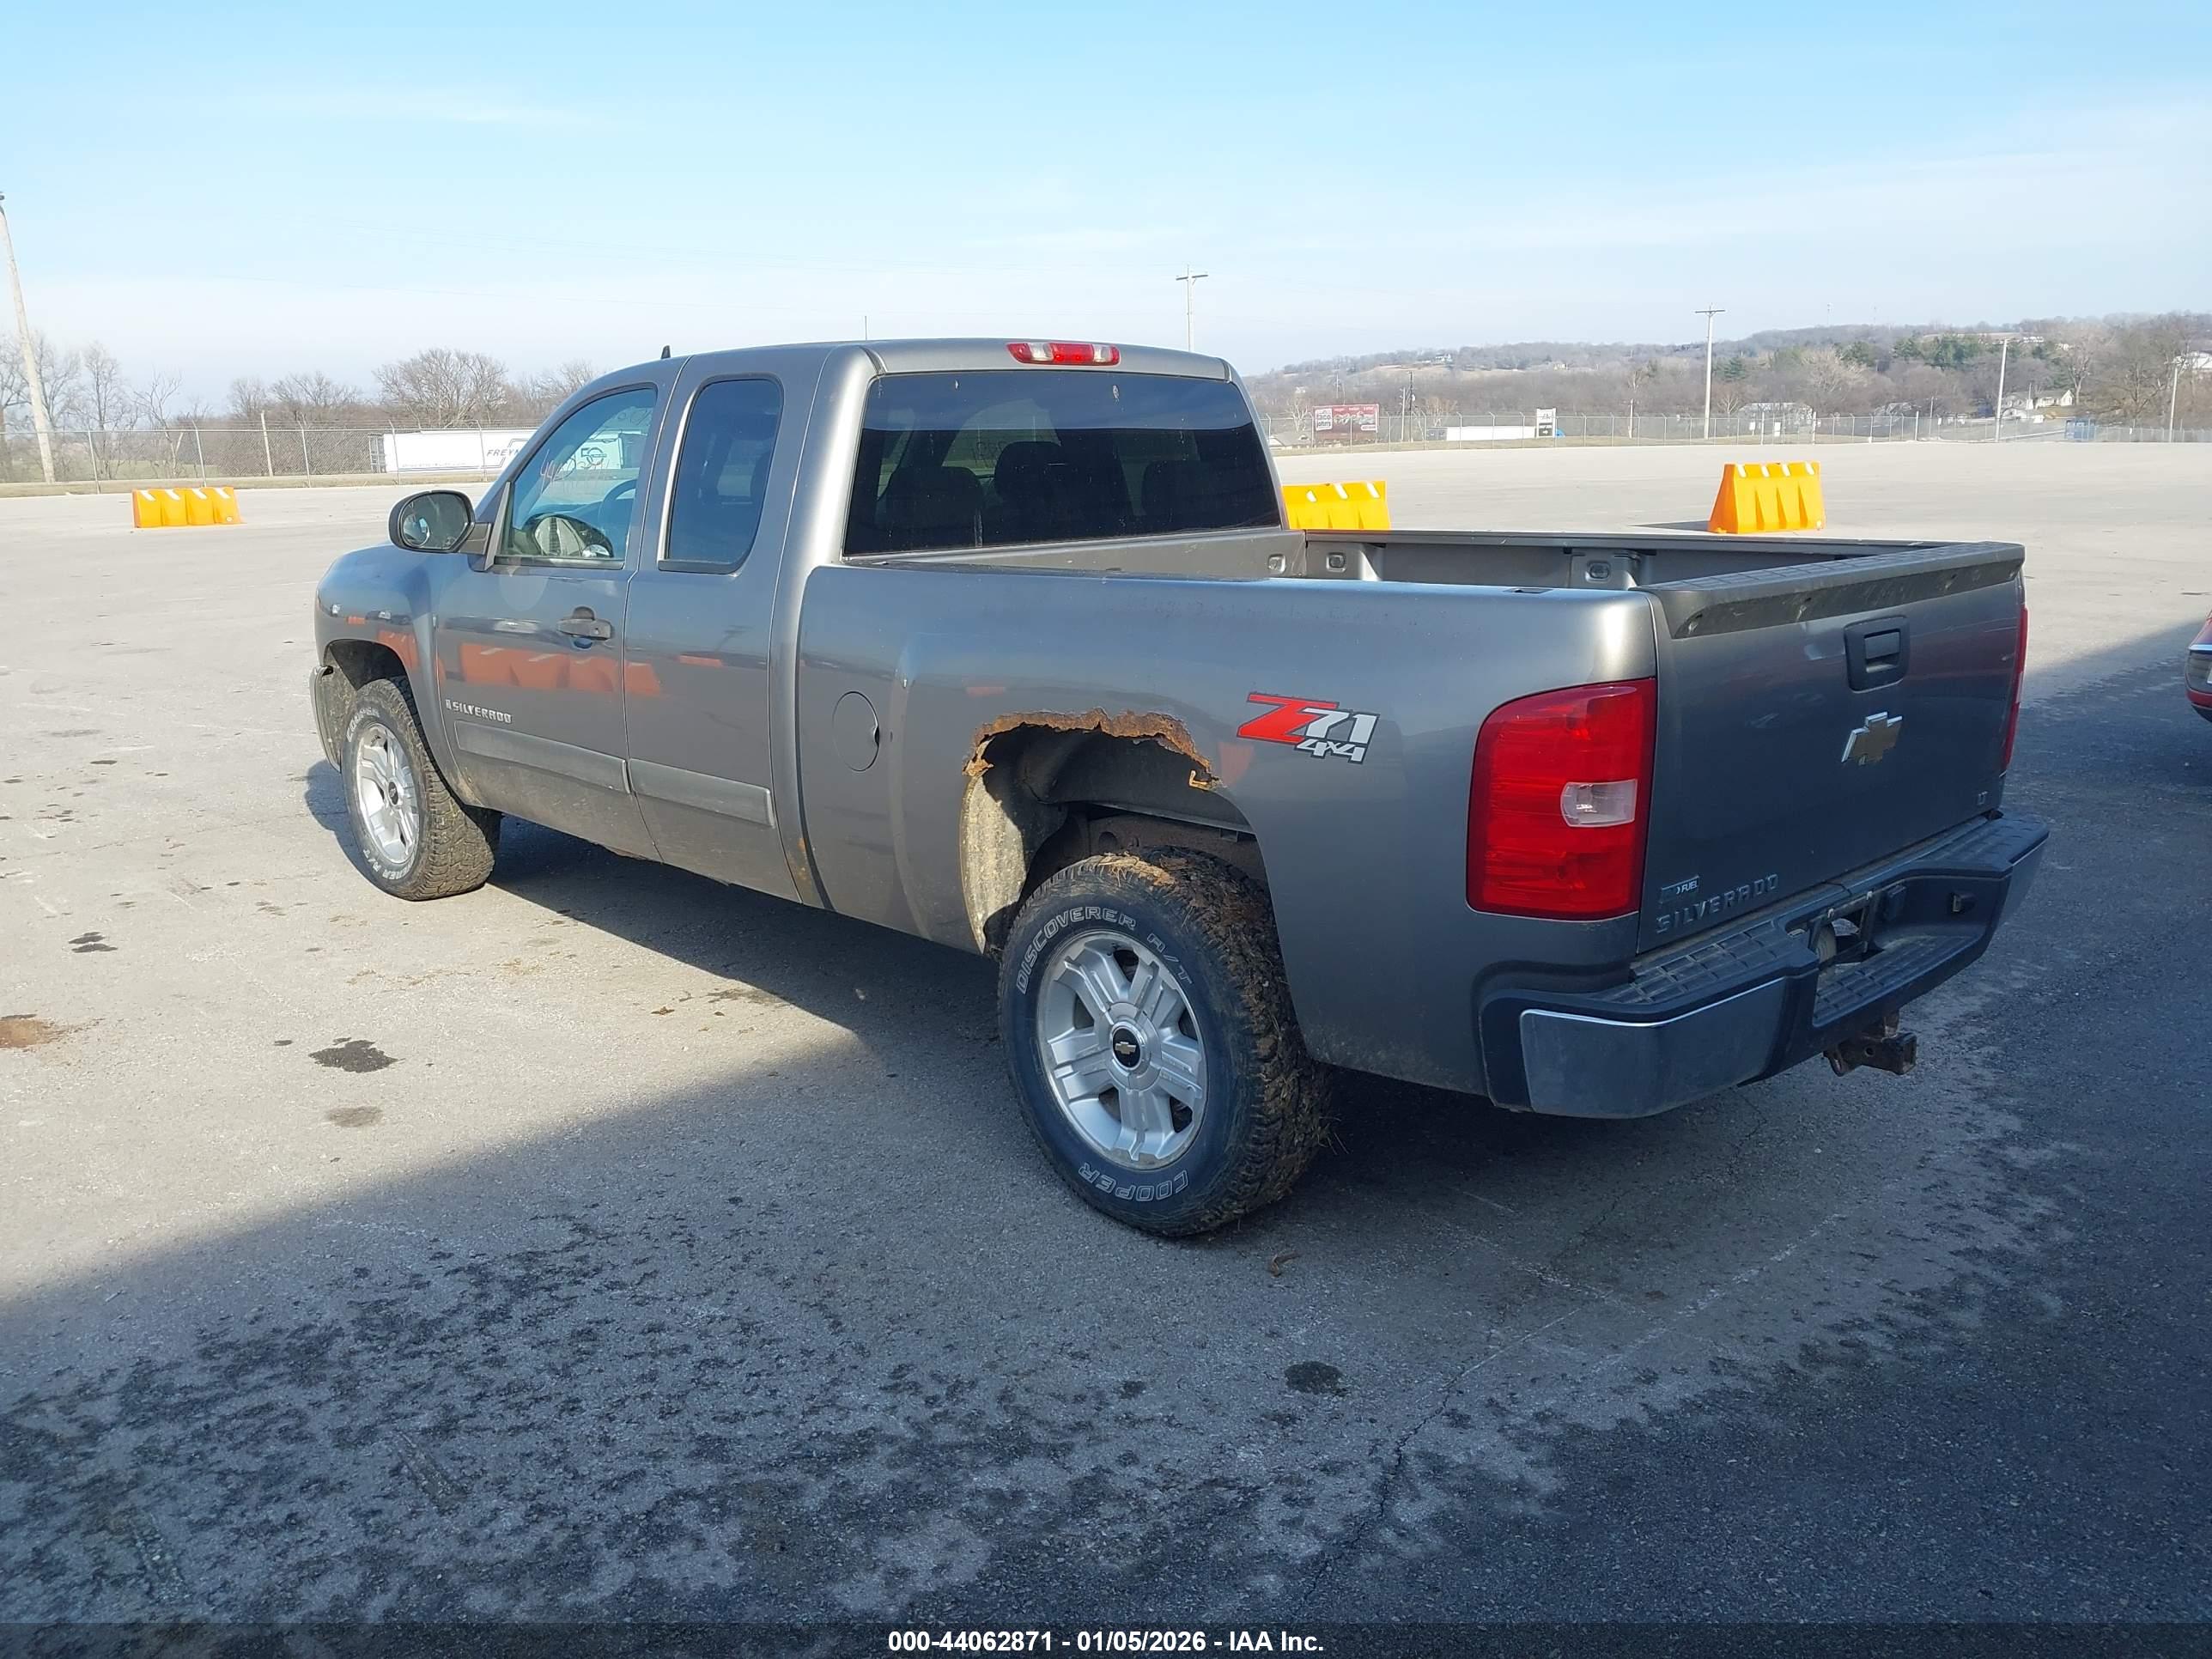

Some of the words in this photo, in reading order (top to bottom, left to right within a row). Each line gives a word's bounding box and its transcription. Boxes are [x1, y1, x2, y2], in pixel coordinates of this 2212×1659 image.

[452, 701, 513, 724] SILVERADO
[1237, 691, 1381, 745] Z71
[1656, 873, 1779, 934] SILVERADO
[1016, 905, 1137, 995] DISCOVERER
[1146, 932, 1194, 986] A/T
[1078, 1162, 1189, 1202] COOPER
